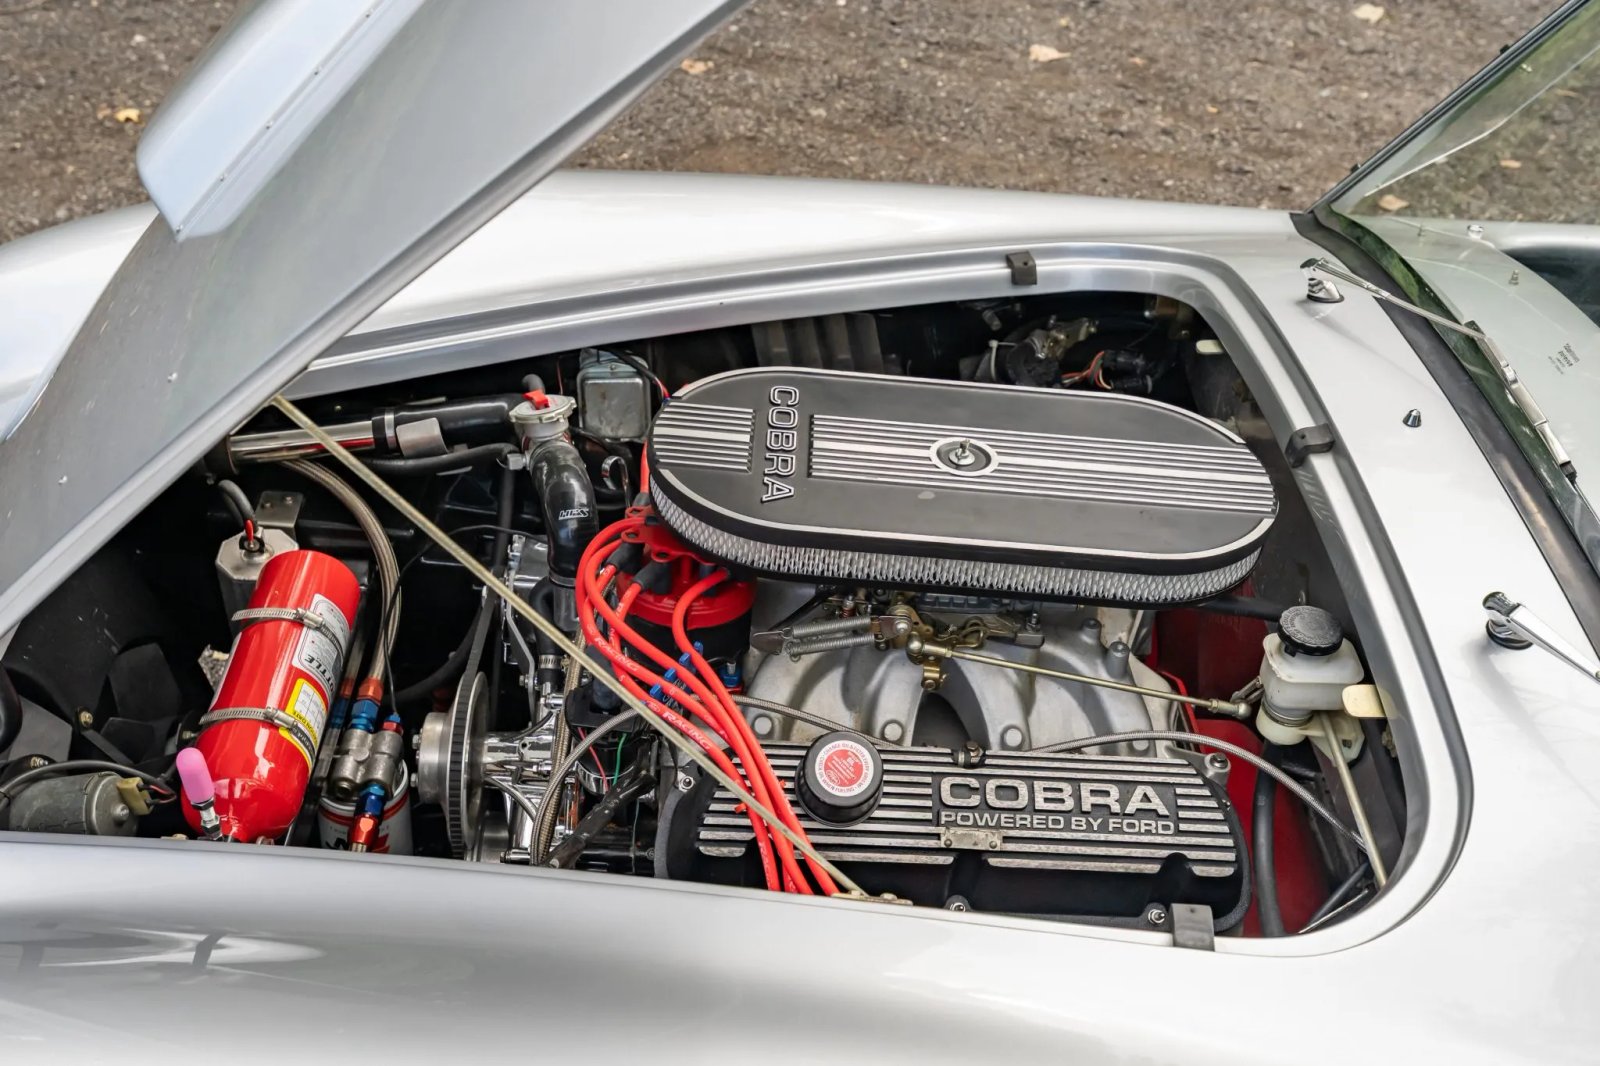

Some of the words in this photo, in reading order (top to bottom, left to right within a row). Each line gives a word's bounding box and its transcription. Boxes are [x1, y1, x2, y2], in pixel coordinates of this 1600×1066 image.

[762, 385, 799, 502] COBRA
[662, 711, 710, 749] RACING
[940, 776, 1170, 817] COBRA
[940, 811, 1064, 830] POWERED
[1070, 816, 1104, 832] BY
[1108, 818, 1175, 836] FORD
